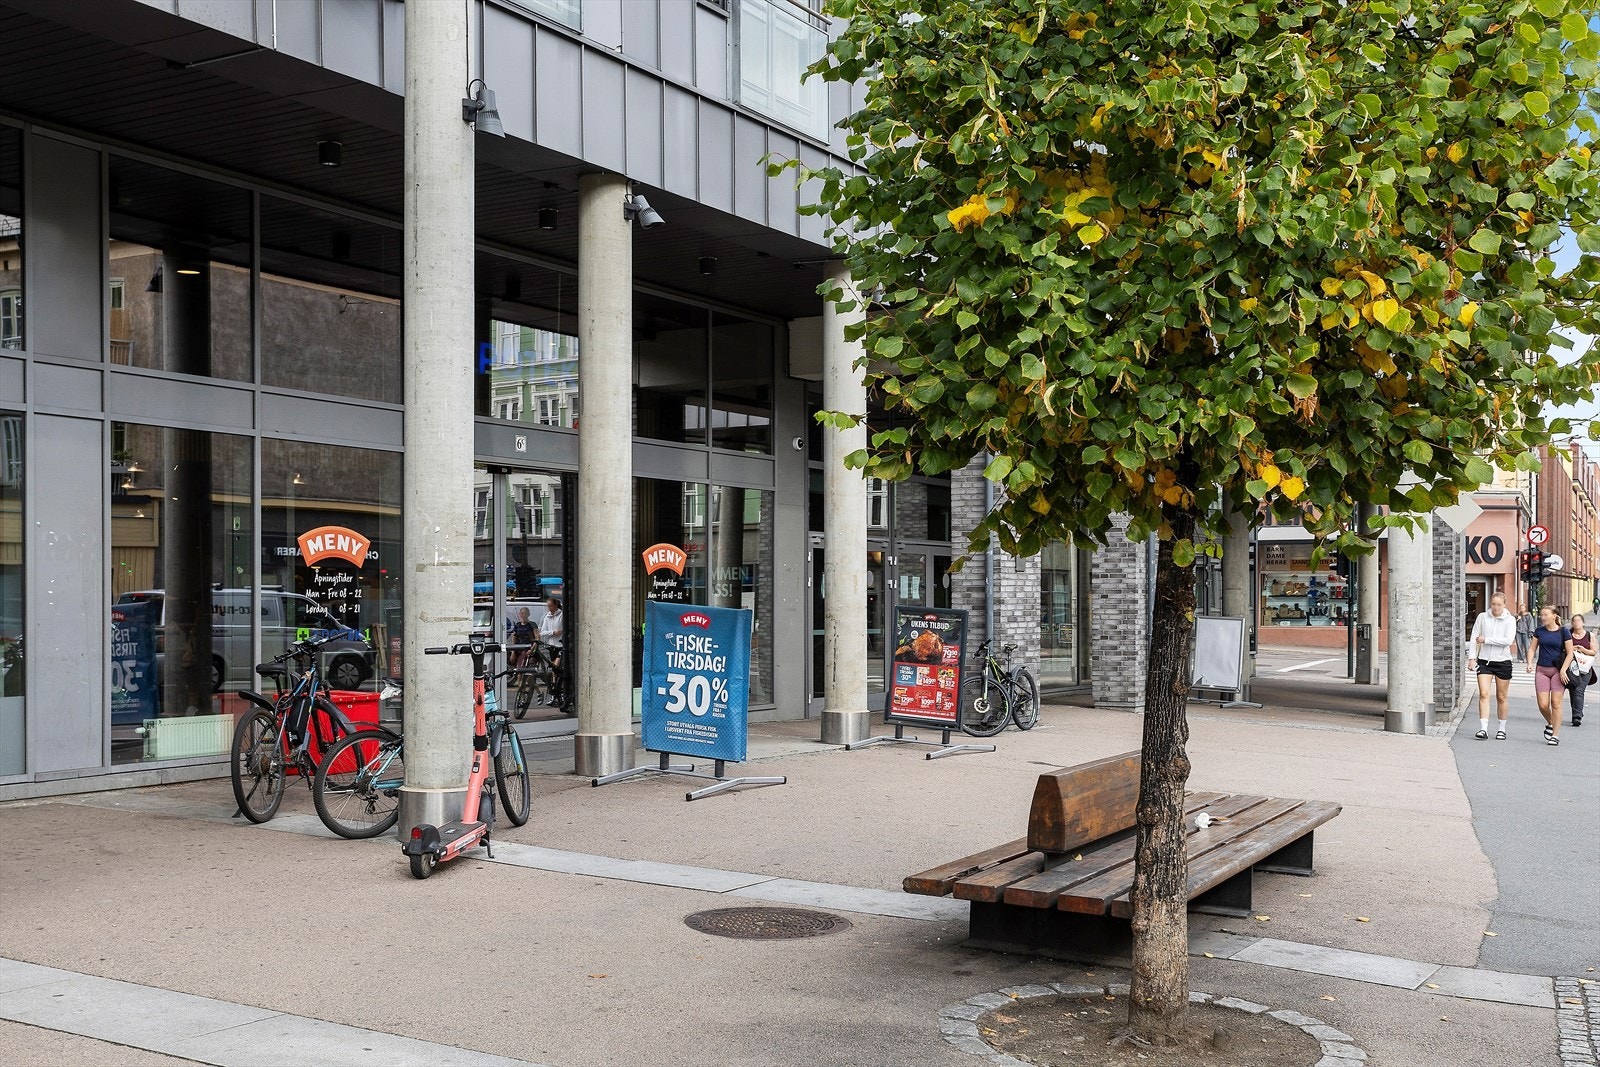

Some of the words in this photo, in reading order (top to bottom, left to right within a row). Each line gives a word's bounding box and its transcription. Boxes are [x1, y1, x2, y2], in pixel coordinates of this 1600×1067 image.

[306, 533, 364, 556] MENY
[1465, 535, 1504, 565] KO
[647, 549, 683, 567] MENY
[314, 568, 354, 586] Åpningstider
[305, 588, 320, 599] Man
[327, 587, 338, 599] Fre
[339, 587, 347, 599] 08
[354, 588, 362, 598] 22
[305, 603, 328, 618] Lørdag
[338, 603, 347, 613] 08
[354, 604, 361, 613] 21
[683, 615, 708, 625] MENY
[910, 620, 929, 629] UKENS
[929, 621, 950, 630] TILBUD
[676, 633, 719, 654] FISKE-
[665, 651, 727, 673] TIRSDAG!
[657, 672, 729, 717] -30%
